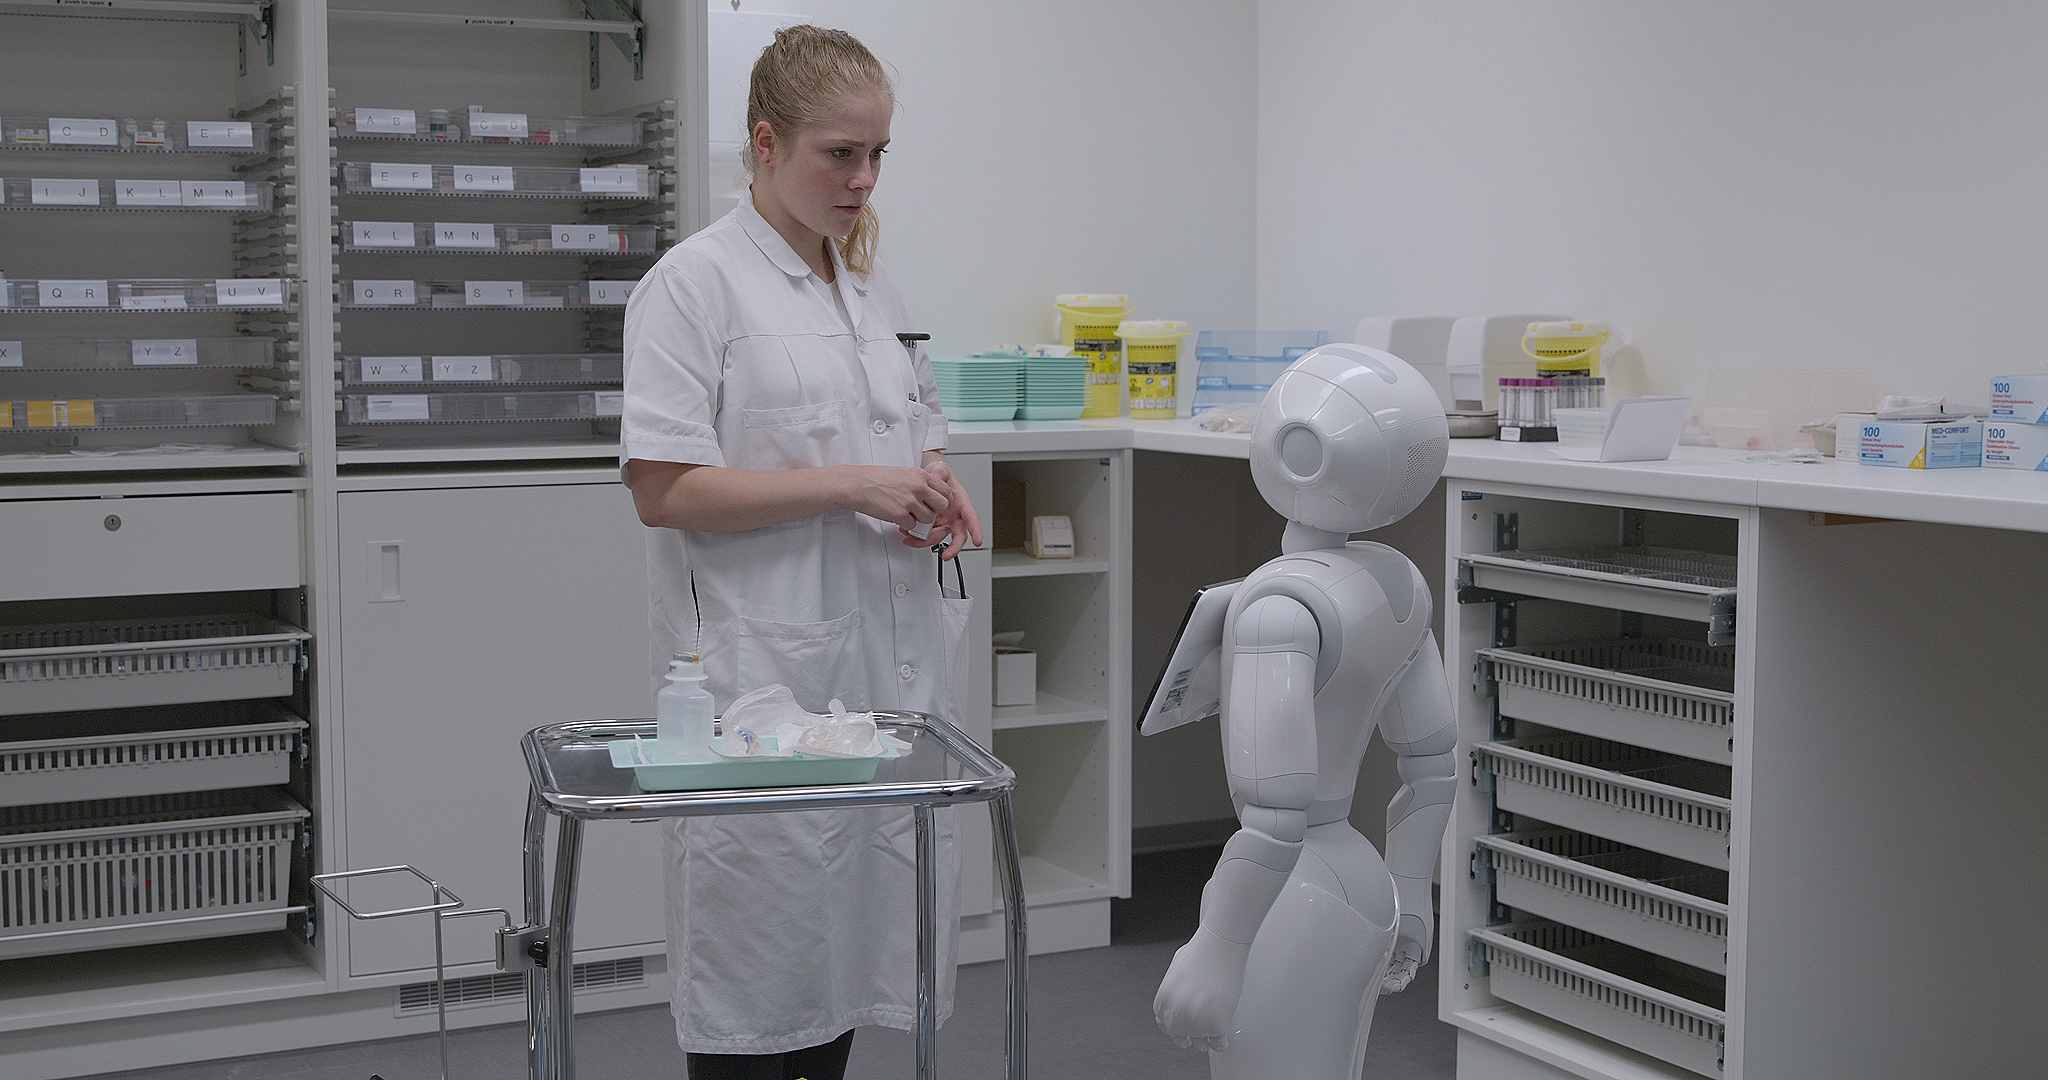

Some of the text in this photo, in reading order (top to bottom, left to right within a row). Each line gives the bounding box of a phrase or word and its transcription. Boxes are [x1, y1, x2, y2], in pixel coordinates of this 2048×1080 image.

[366, 116, 401, 126] A B
[480, 120, 518, 130] C D
[62, 126, 109, 136] C D
[200, 128, 234, 138] E F
[381, 172, 420, 181] E F
[464, 174, 499, 184] G H
[617, 176, 622, 185] J
[45, 188, 85, 197] I J
[126, 188, 166, 198] K L
[194, 189, 233, 198] M N
[364, 230, 399, 240] K L
[444, 231, 479, 240] M N
[561, 233, 596, 242] O P
[52, 288, 94, 298] Q R
[228, 287, 266, 296] U V
[364, 289, 402, 298] Q R
[473, 289, 514, 298] S T
[598, 290, 606, 298] U
[0, 349, 7, 358] X
[144, 347, 182, 356] Y Z
[370, 364, 408, 375] W X
[444, 364, 478, 374] Y Z
[1994, 382, 2010, 393] 100
[1863, 427, 1880, 437] 100
[1988, 428, 2005, 439] 100
